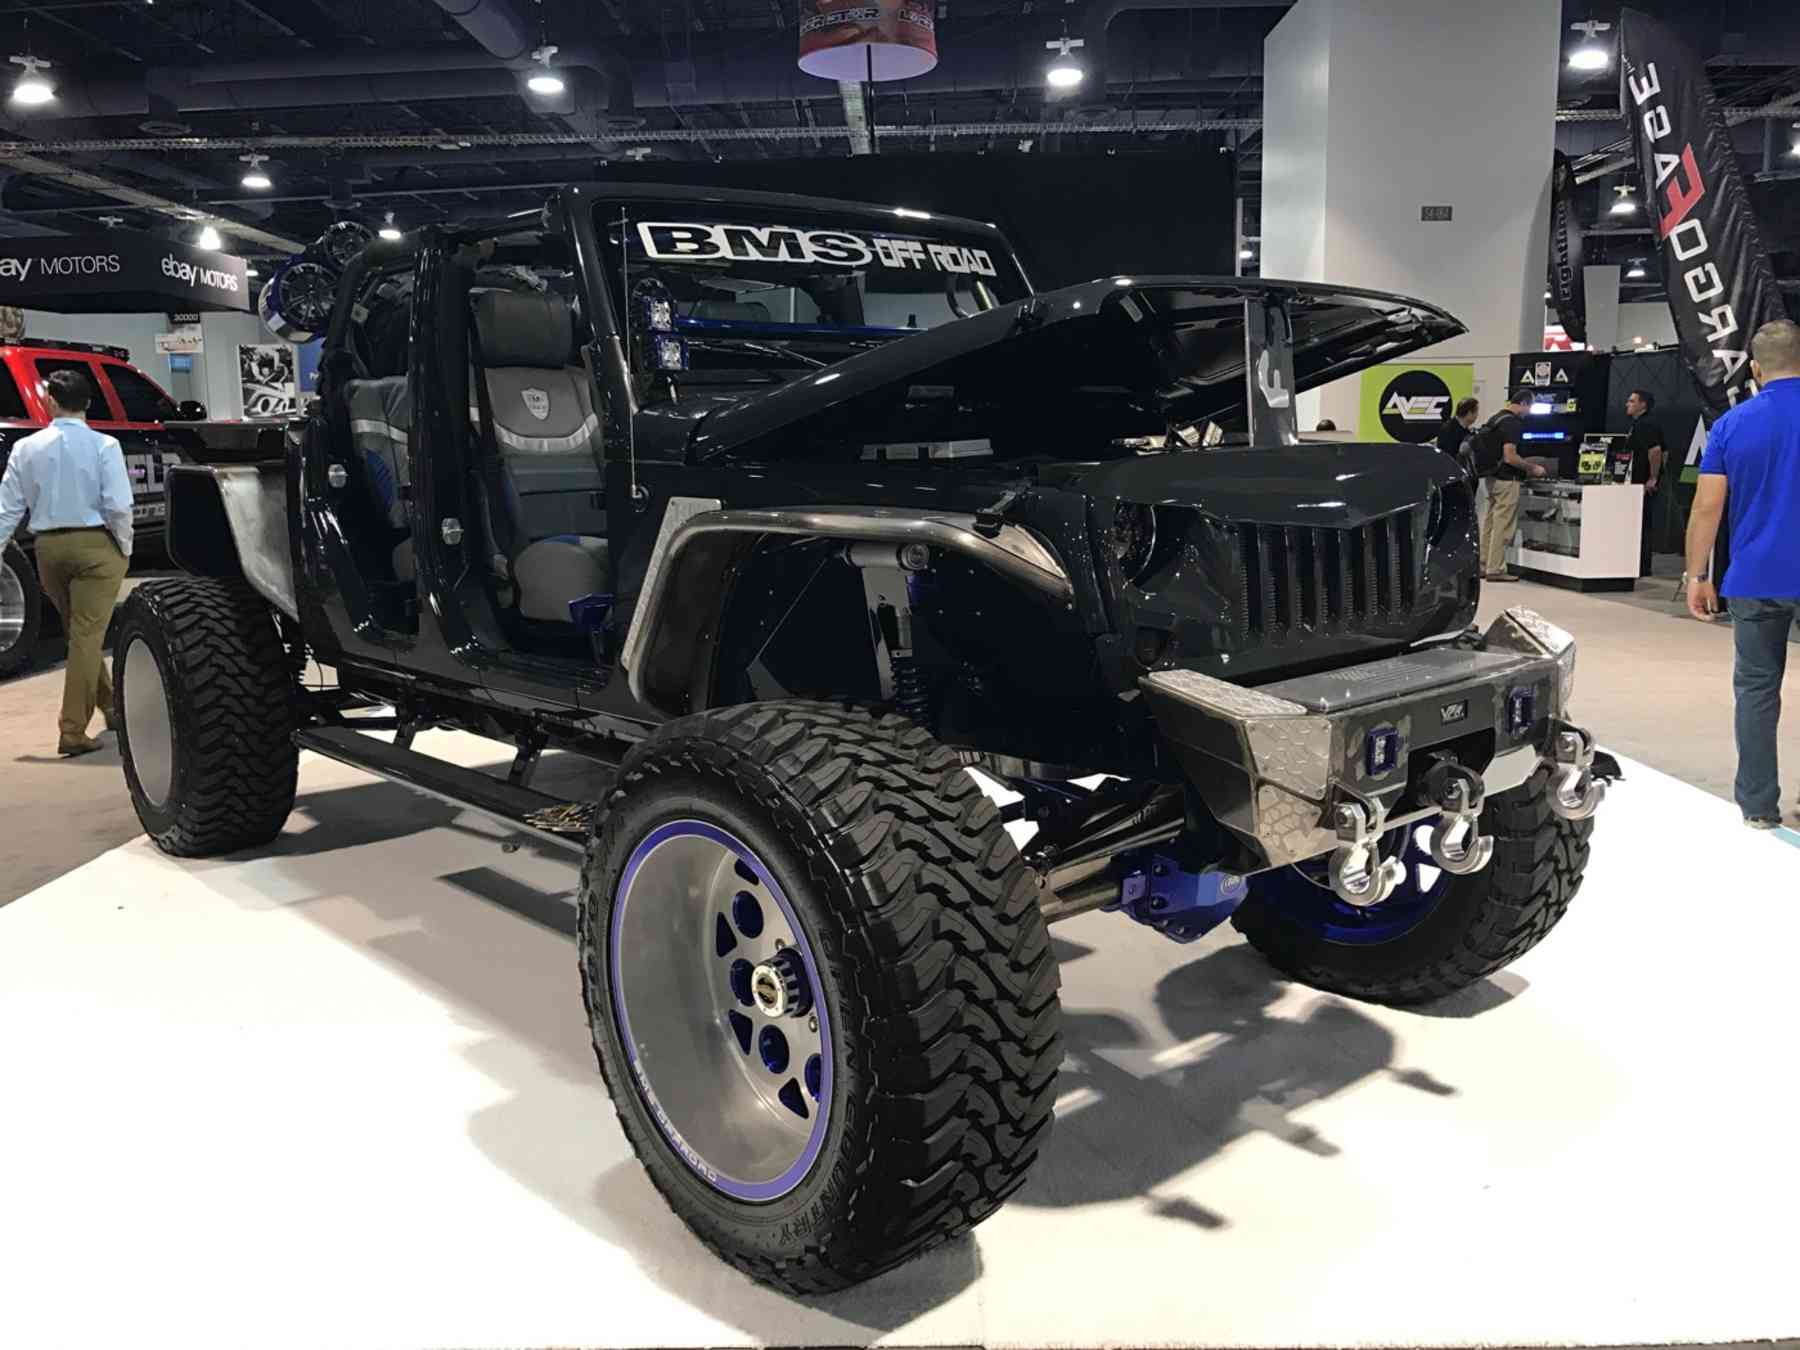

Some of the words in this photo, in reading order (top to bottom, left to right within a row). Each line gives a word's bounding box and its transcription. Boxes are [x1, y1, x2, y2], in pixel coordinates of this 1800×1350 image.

[41, 255, 120, 274] MOTORS
[637, 222, 873, 267] BMS
[873, 238, 926, 270] OFF
[927, 244, 997, 277] ROAD
[161, 253, 197, 287] ebay
[200, 267, 238, 291] MOTORS
